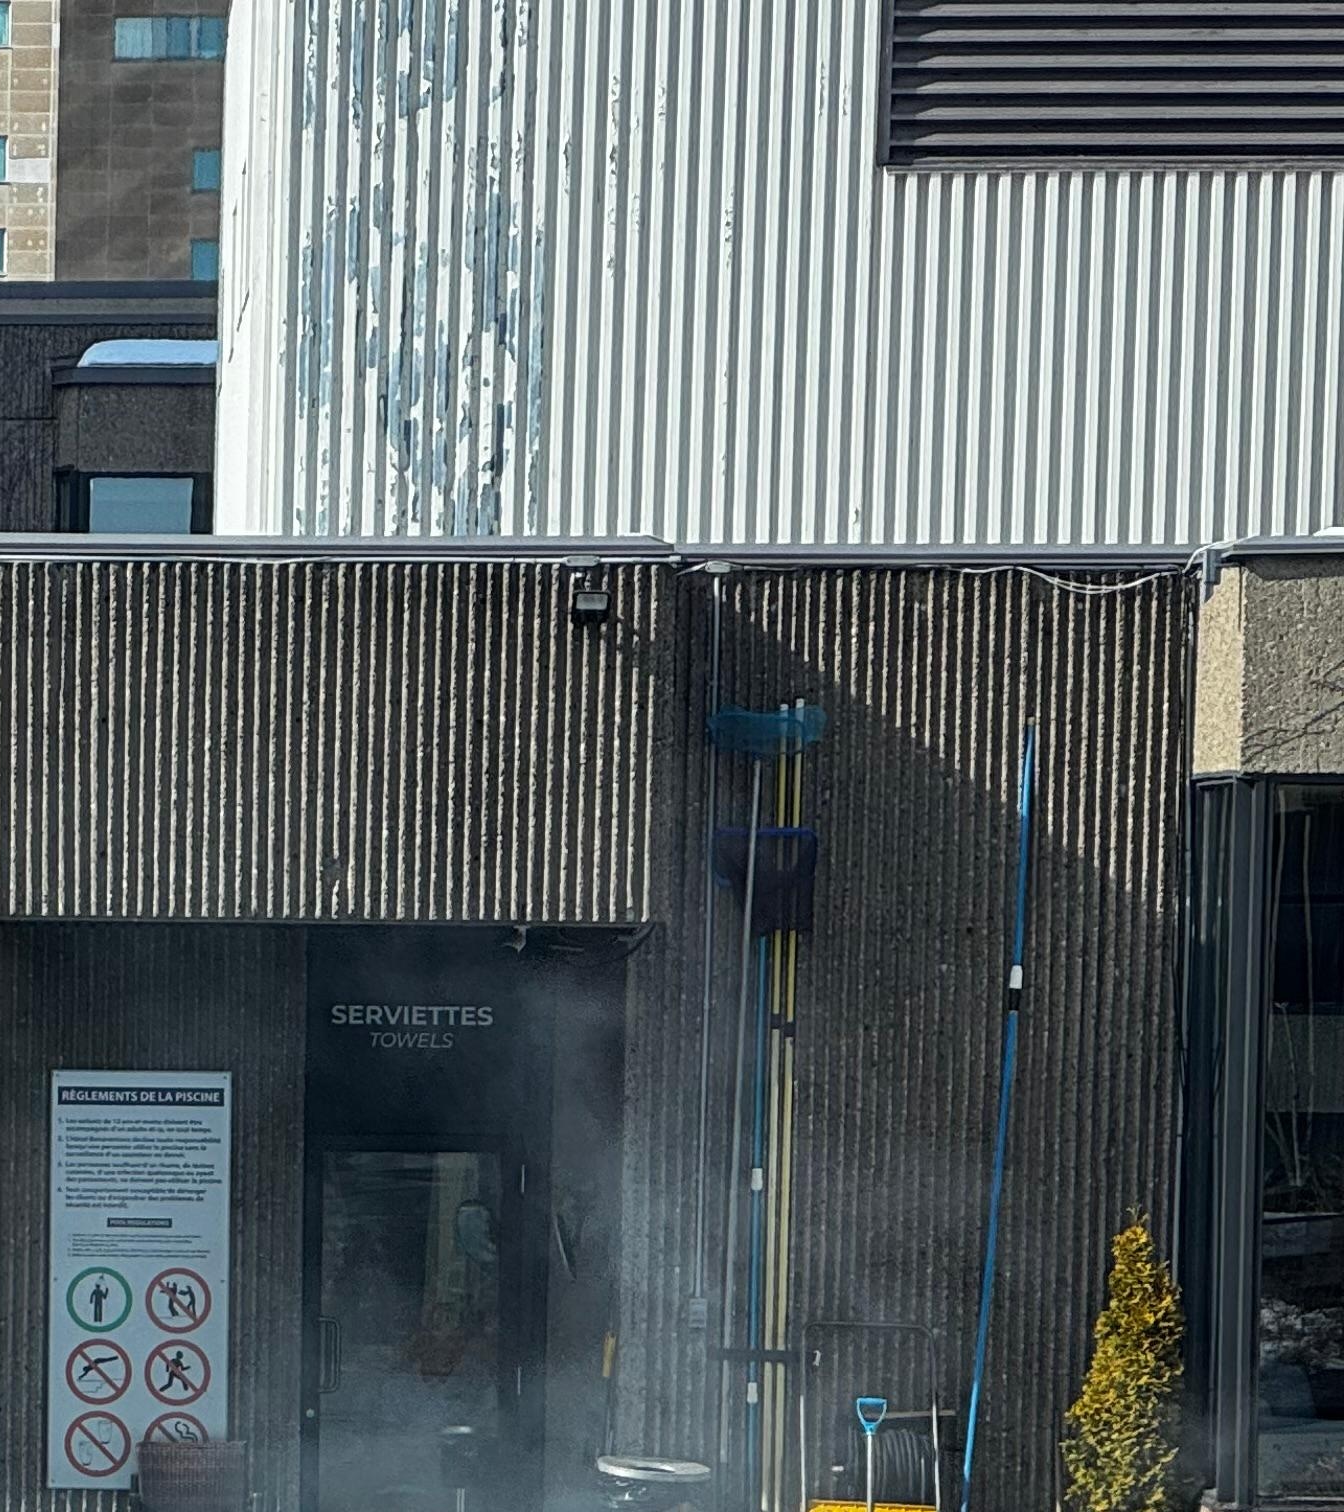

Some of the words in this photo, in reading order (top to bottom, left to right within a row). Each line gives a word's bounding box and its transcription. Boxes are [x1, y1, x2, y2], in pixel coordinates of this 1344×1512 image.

[331, 1005, 494, 1026] SERVIETTES
[370, 1032, 454, 1049] TOWELS
[140, 1091, 155, 1102] DE
[158, 1091, 173, 1102] LA
[175, 1092, 220, 1103] PISCINE
